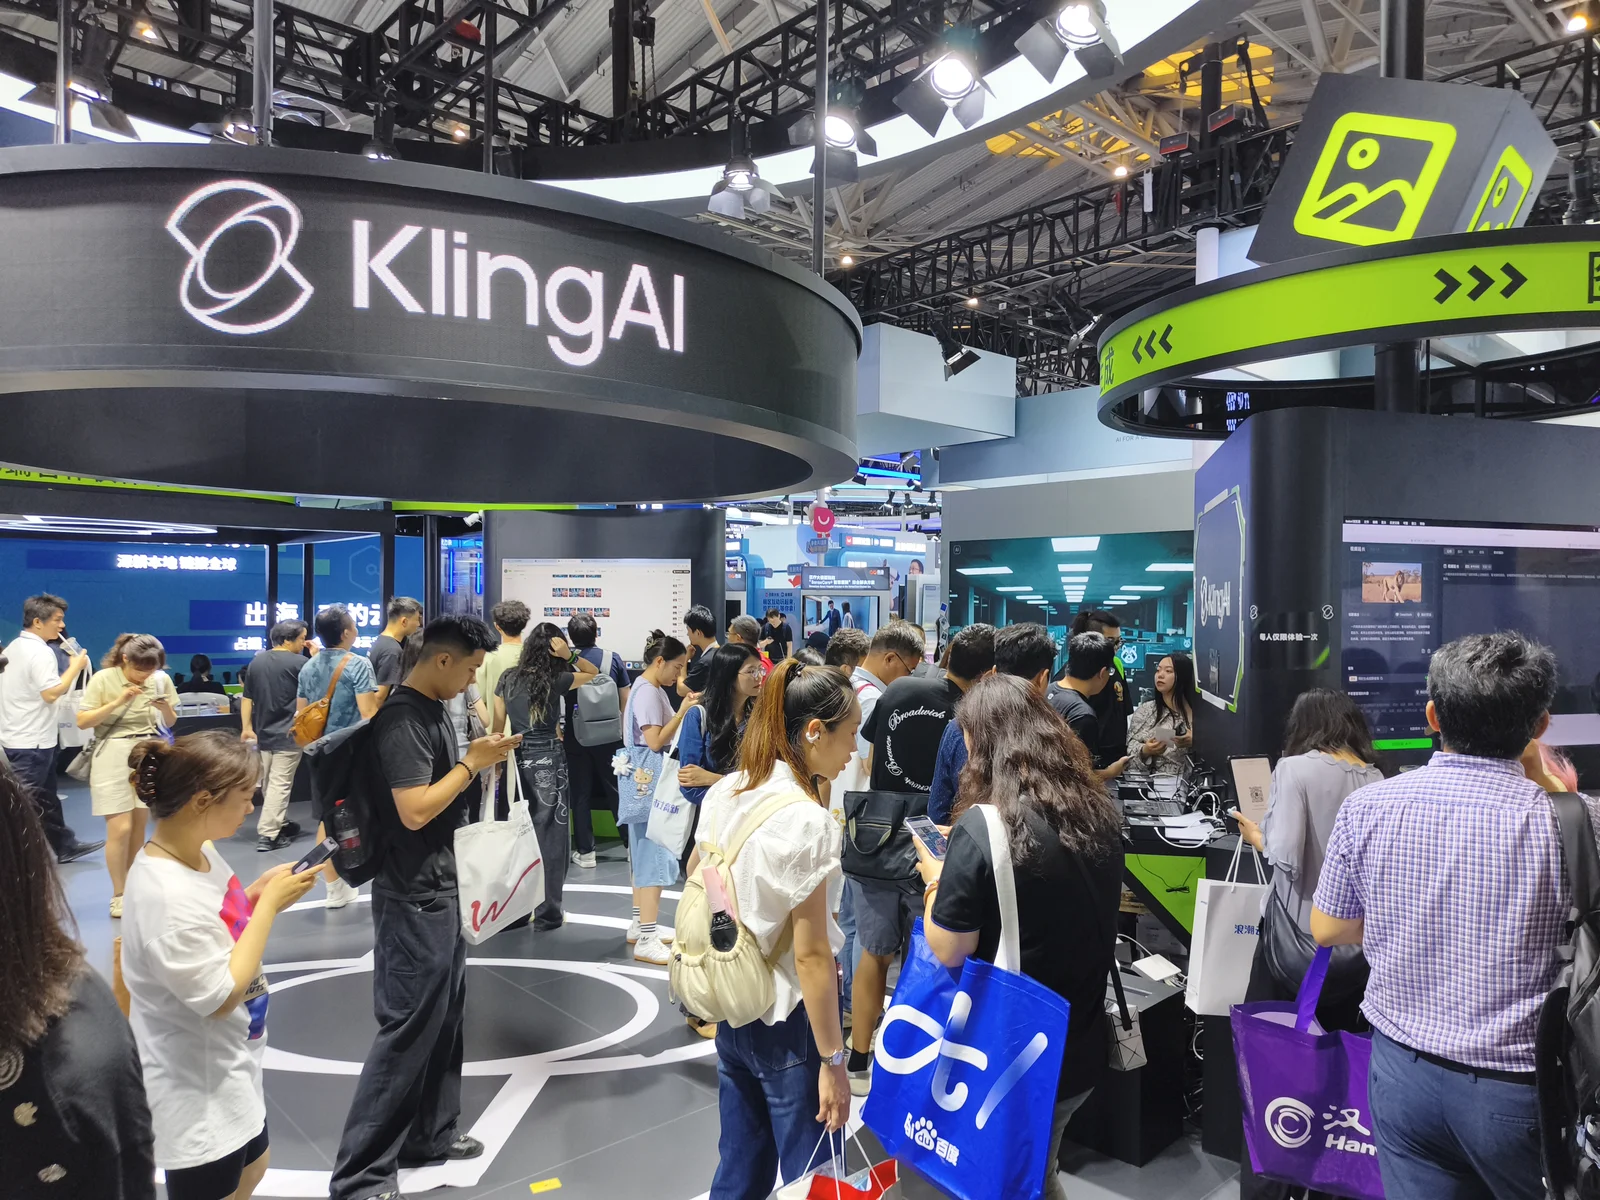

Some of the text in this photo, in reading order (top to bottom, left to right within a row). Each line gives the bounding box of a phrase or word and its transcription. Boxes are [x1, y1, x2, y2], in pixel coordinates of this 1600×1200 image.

[1259, 632, 1318, 641] 每人仅限体验一次
[935, 1136, 960, 1167] 百度
[1325, 1133, 1377, 1156] Han
